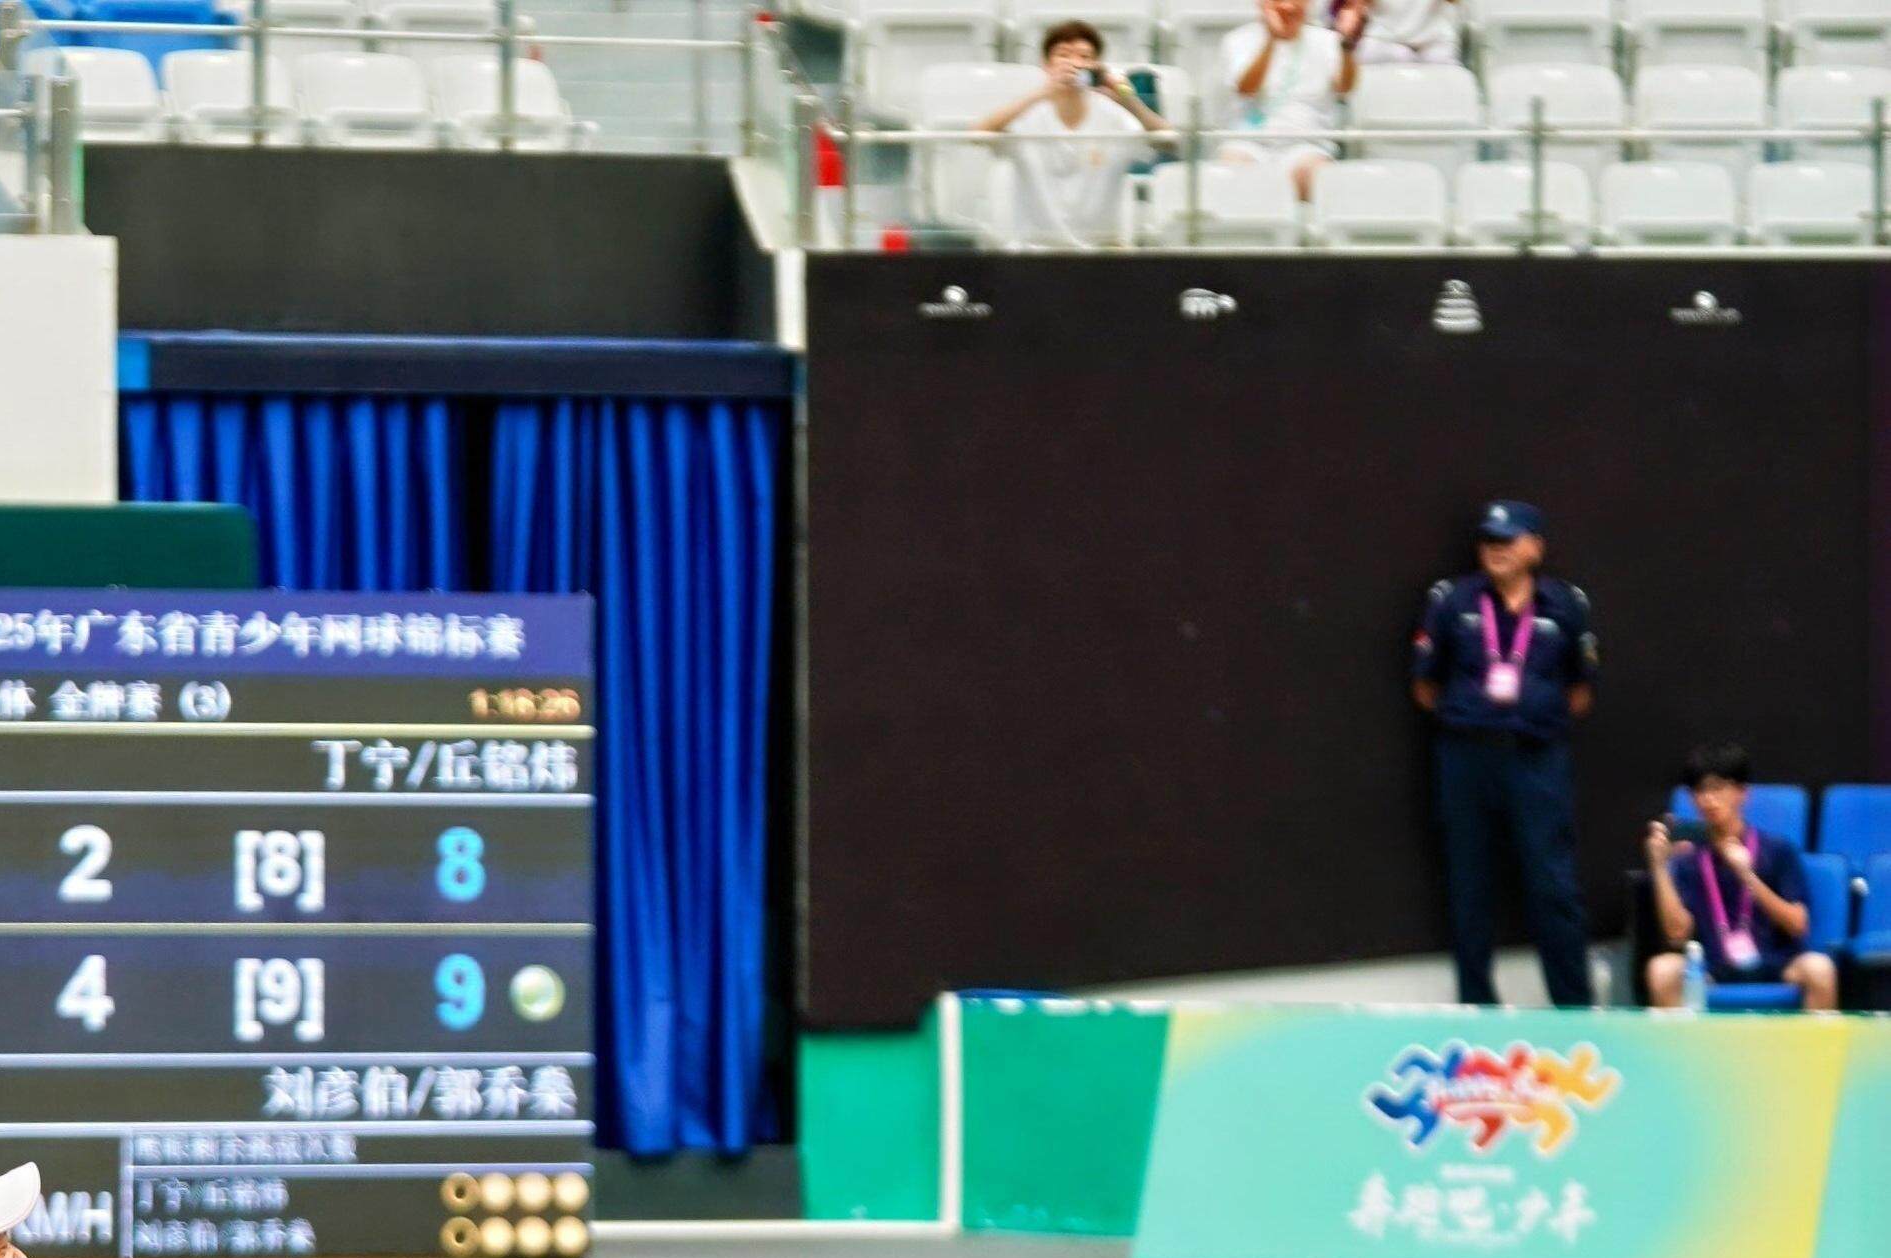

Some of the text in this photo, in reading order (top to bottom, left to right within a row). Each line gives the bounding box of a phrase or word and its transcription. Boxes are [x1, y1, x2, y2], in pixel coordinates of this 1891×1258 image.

[58, 824, 113, 902] 2
[234, 829, 326, 913] [8]
[436, 825, 487, 902] 8
[56, 953, 115, 1034] 4
[234, 957, 326, 1043] [9]
[436, 952, 487, 1032] 9
